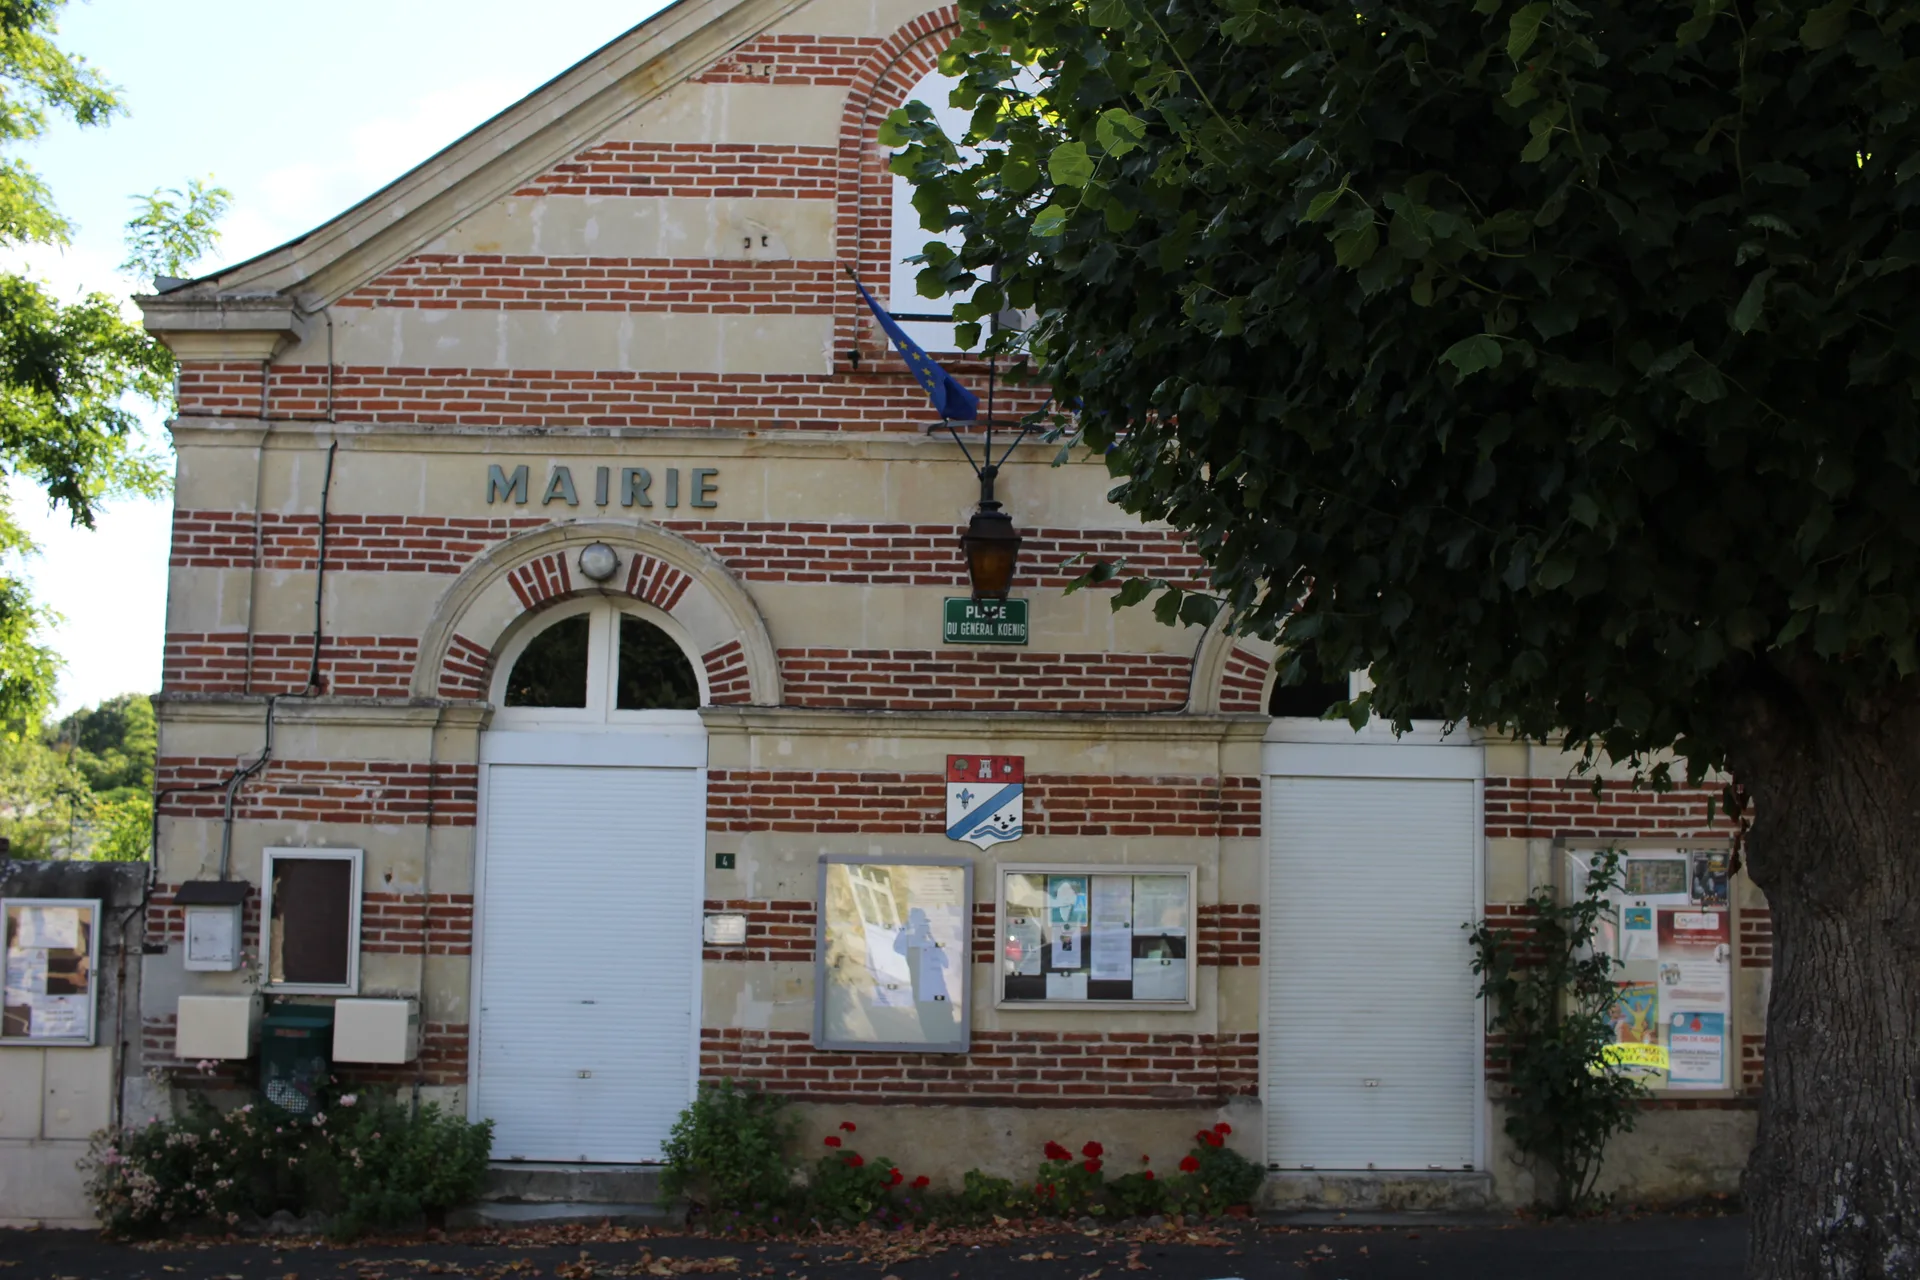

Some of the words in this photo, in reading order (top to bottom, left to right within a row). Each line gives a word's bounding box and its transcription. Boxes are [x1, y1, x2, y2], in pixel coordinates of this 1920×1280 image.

[486, 464, 718, 508] MAIRIE
[947, 622, 958, 635] DU
[997, 623, 1025, 636] KOENIG
[722, 855, 728, 867] 4
